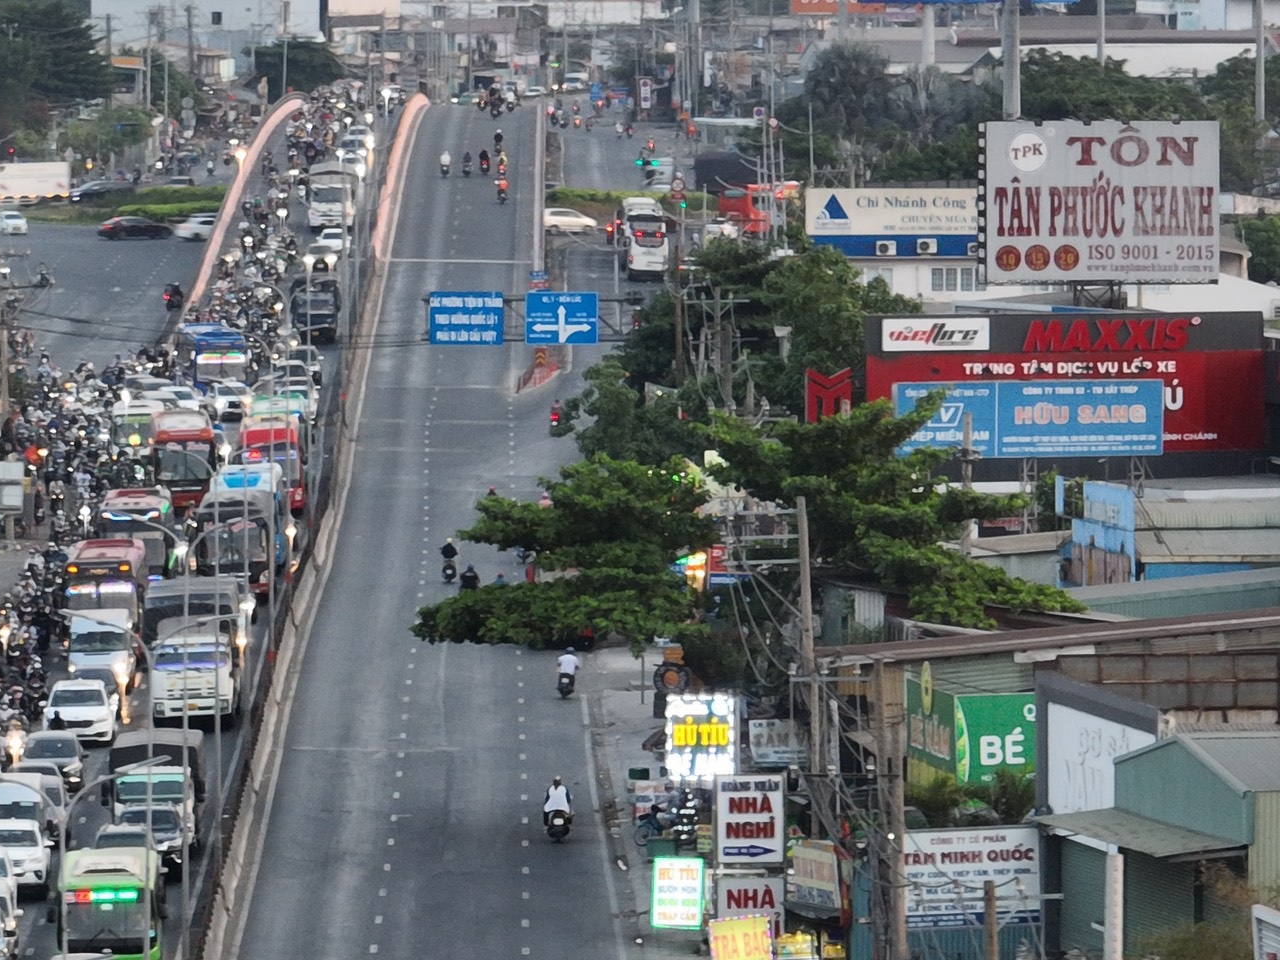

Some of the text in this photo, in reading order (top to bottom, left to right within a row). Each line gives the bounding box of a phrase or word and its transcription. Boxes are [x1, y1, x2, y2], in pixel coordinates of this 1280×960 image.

[1011, 143, 1043, 160] TPK
[1066, 124, 1199, 167] TÔN
[856, 196, 966, 210] Chi Nhánh Công
[994, 170, 1214, 238] TÂN PHƯỚC KHANH
[1088, 245, 1116, 261] ISO
[1121, 245, 1159, 261] 9001
[1176, 245, 1215, 261] 2015
[1023, 317, 1190, 352] MAXXIS
[1097, 361, 1119, 376] VỤ
[1157, 361, 1176, 373] XE
[1014, 402, 1147, 425] HỮU SANG
[728, 792, 773, 814] NHÀ
[726, 816, 775, 839] NGHỈ
[941, 851, 983, 864] MINH
[987, 843, 1035, 862] QUỐC
[726, 884, 775, 910] NHÀ
